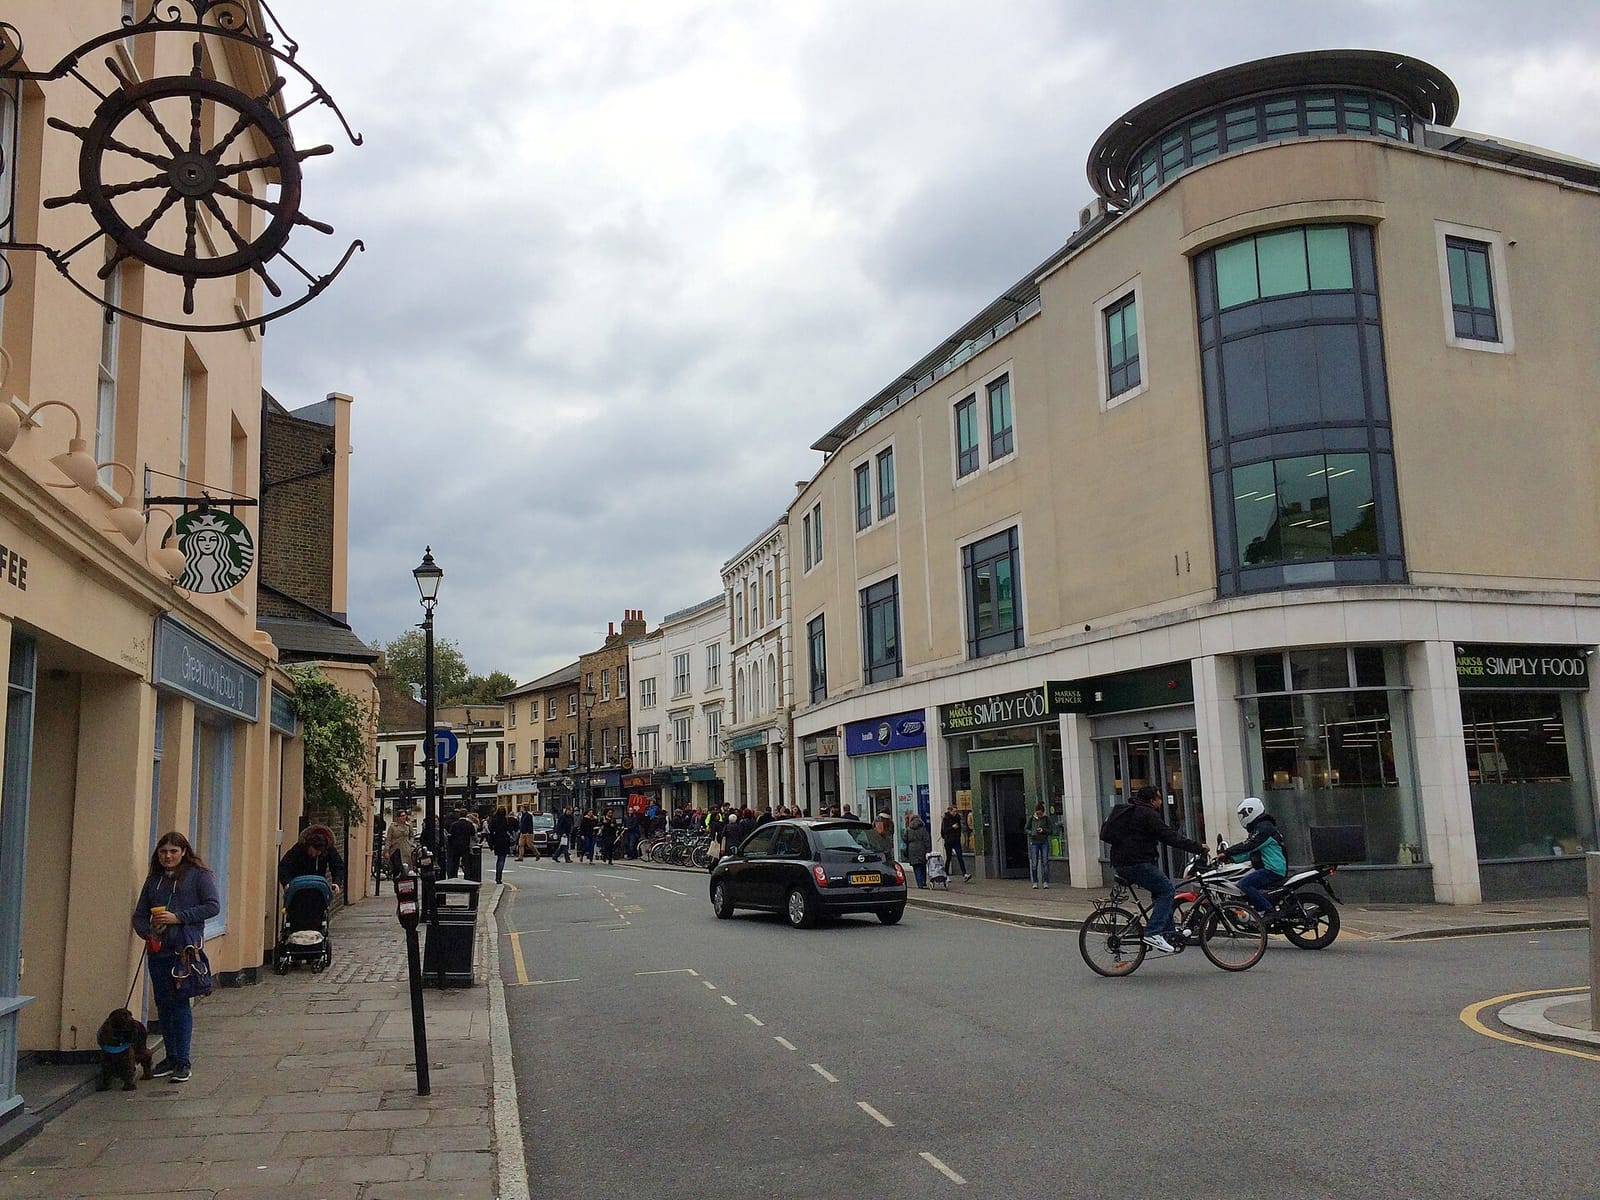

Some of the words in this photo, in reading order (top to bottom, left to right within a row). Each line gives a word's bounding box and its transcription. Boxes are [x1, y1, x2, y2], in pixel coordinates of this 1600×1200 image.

[1456, 657, 1476, 666] ARKS
[1486, 657, 1538, 675] SIMPLY
[1541, 658, 1585, 676] FOOD
[1456, 666, 1485, 676] PENCER
[949, 707, 967, 719] MARKS
[974, 700, 1013, 725] SIMPLY
[1017, 695, 1044, 718] FOO
[949, 716, 974, 729] SPENCER
